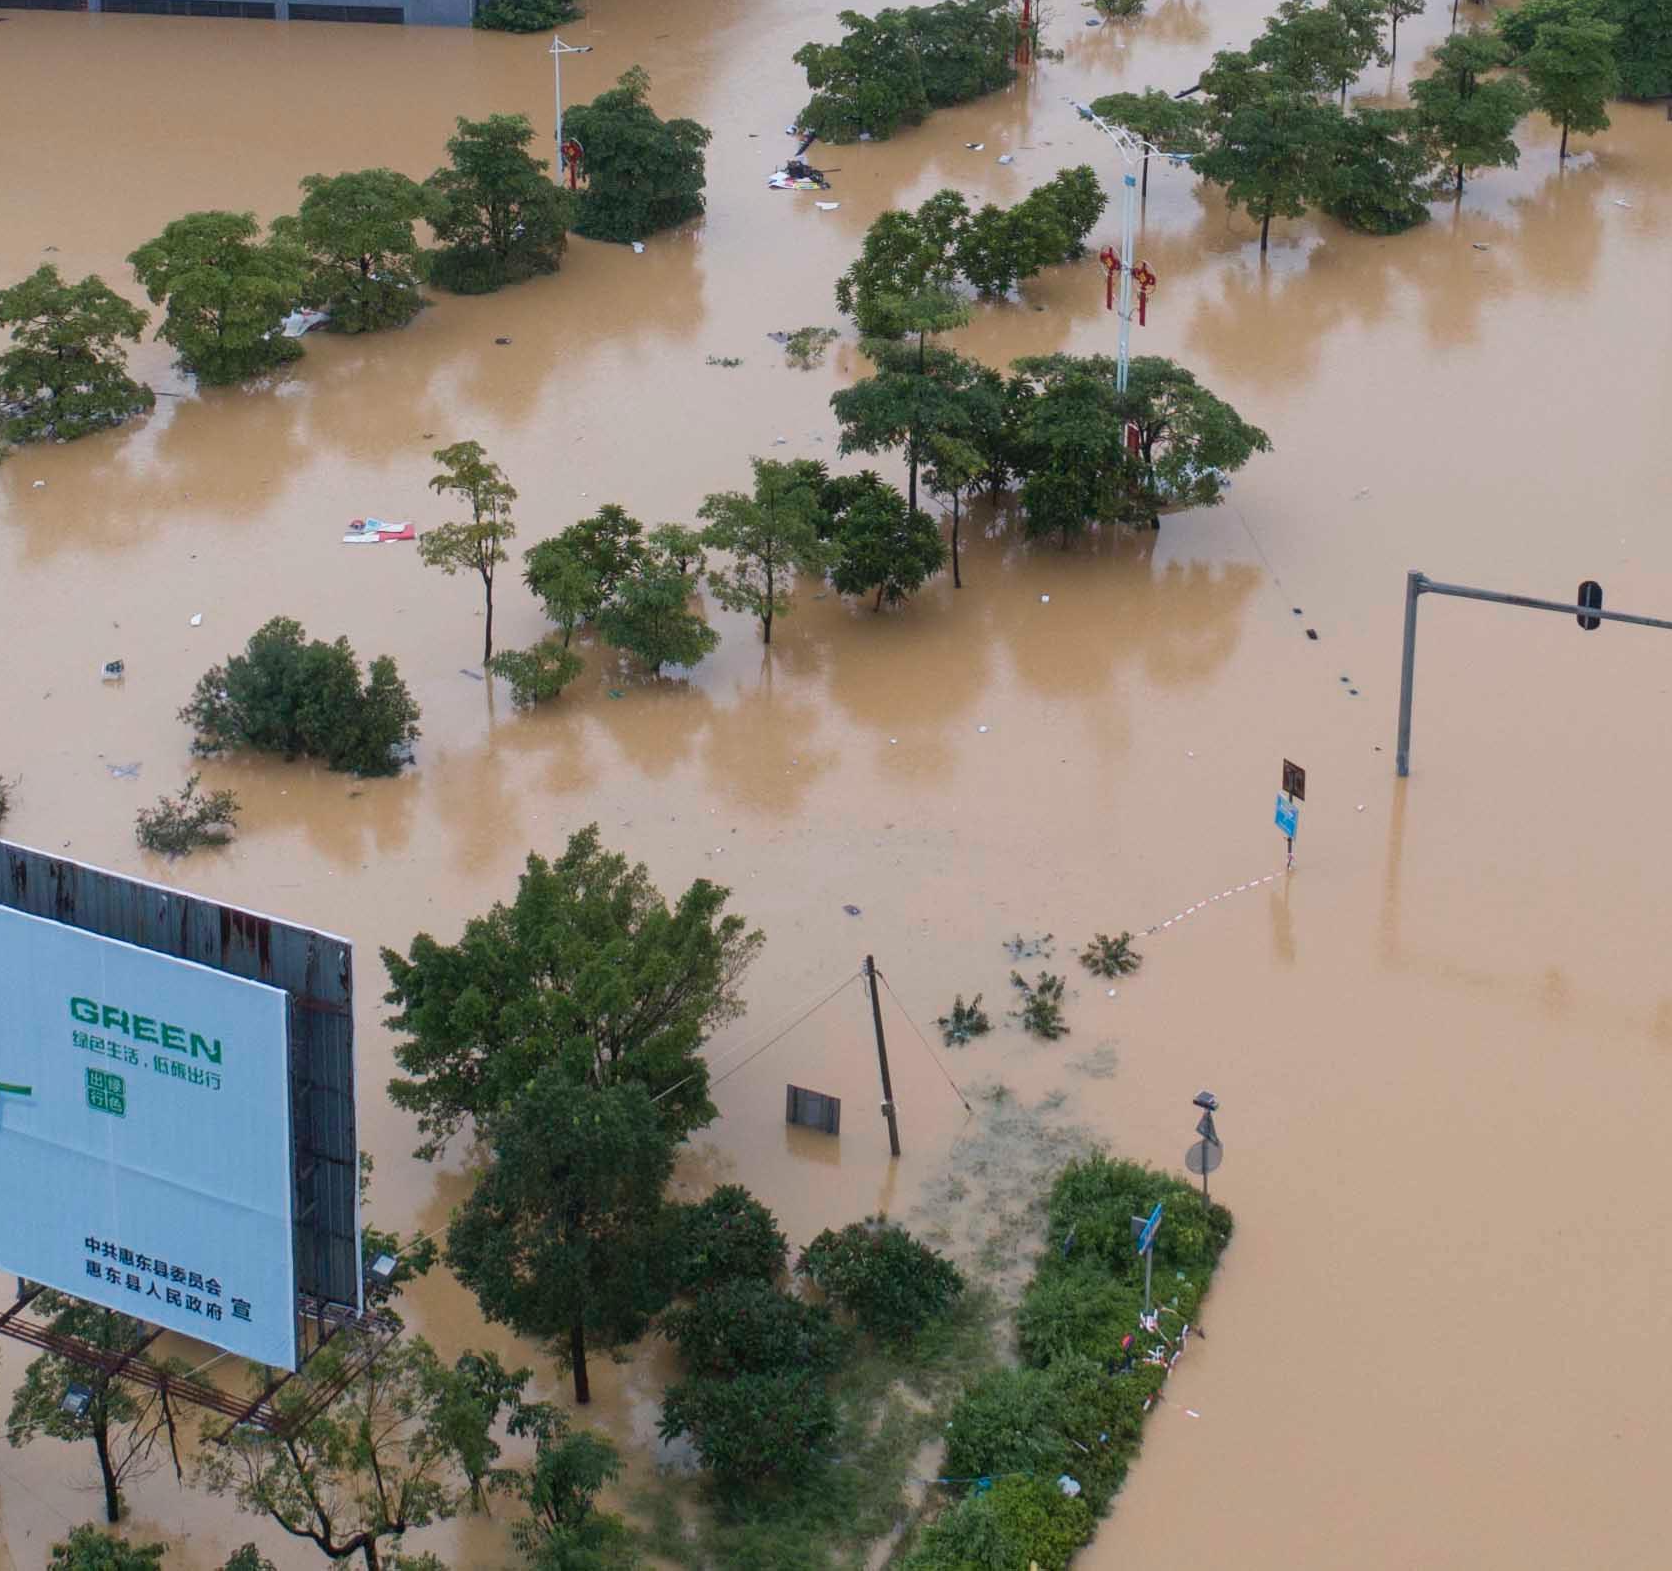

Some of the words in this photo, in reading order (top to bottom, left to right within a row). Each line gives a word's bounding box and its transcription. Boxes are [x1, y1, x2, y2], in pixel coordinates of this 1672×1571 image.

[70, 996, 222, 1065] GREEN
[85, 1236, 222, 1297] 中共惠东县委员会
[85, 1259, 223, 1321] 惠东县人民政府
[231, 1296, 253, 1323] 宣
